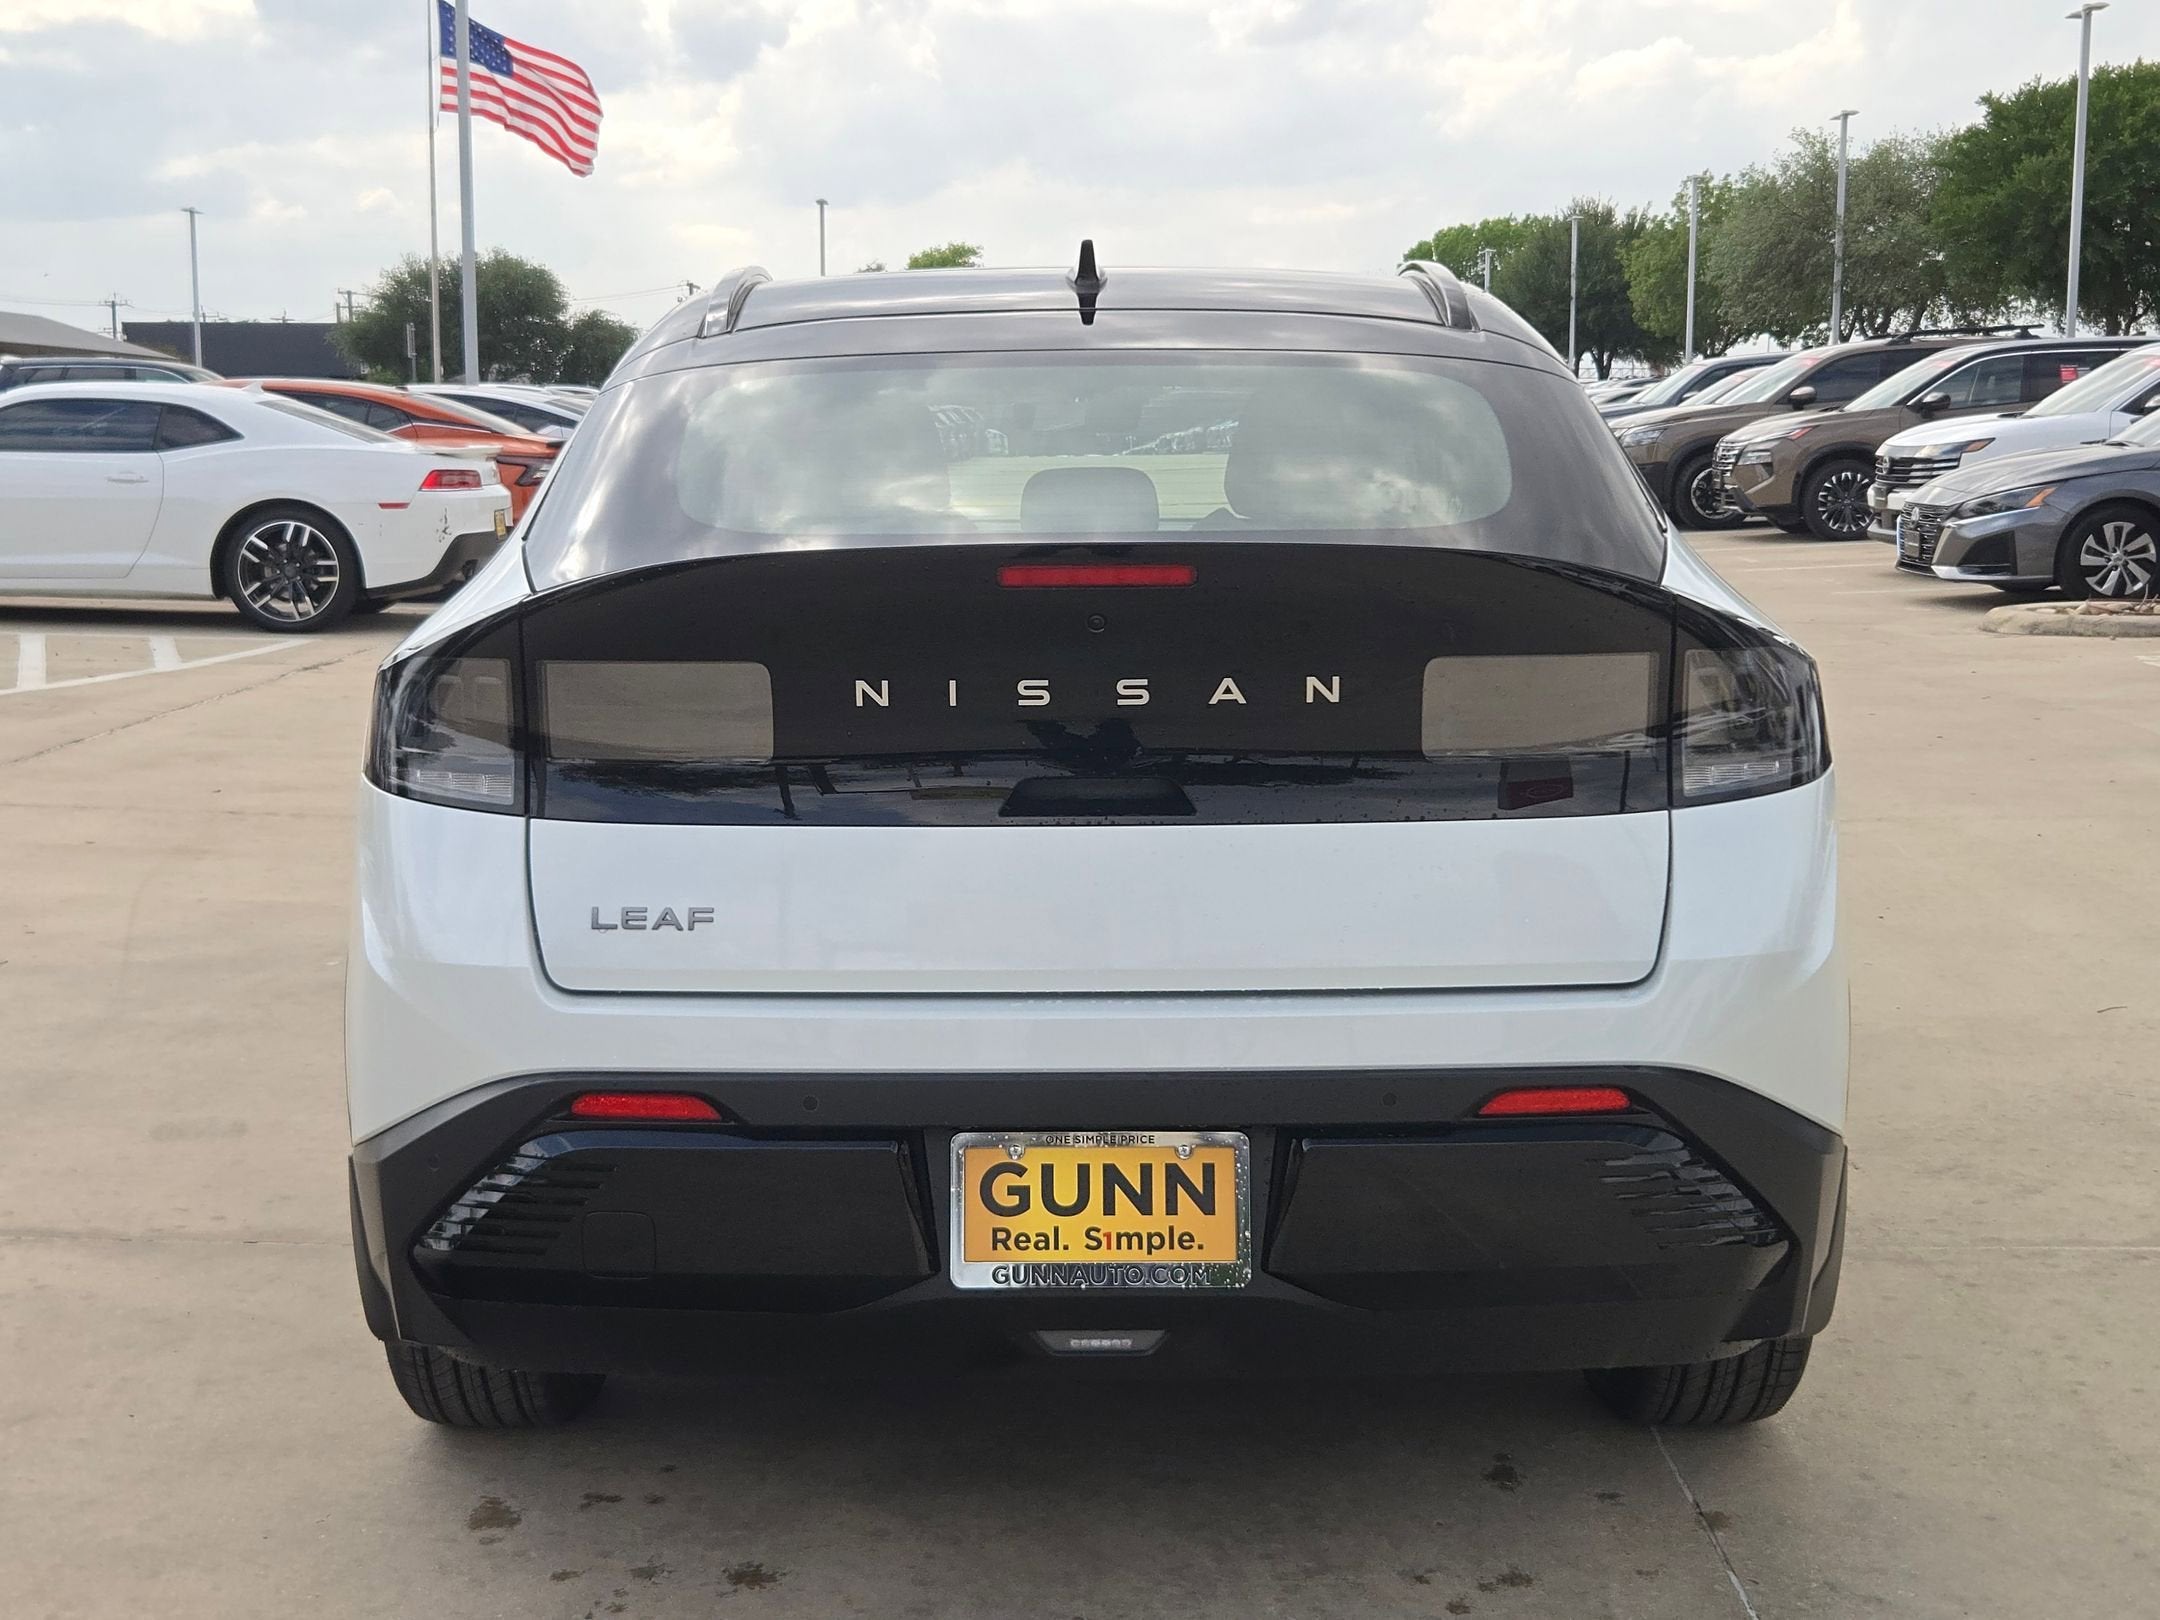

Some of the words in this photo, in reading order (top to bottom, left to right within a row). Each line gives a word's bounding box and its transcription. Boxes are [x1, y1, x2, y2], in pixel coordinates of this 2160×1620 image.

[855, 676, 1340, 707] NISSAN
[591, 906, 715, 931] LEAF
[1045, 1135, 1071, 1144] ONE
[1074, 1135, 1117, 1144] SIMPLE
[1120, 1135, 1156, 1144] PRICE
[979, 1161, 1217, 1218] GUNN
[991, 1226, 1070, 1251] Real.
[1084, 1225, 1204, 1255] S1mple.
[991, 1264, 1211, 1286] GUNNAUTO.COM
